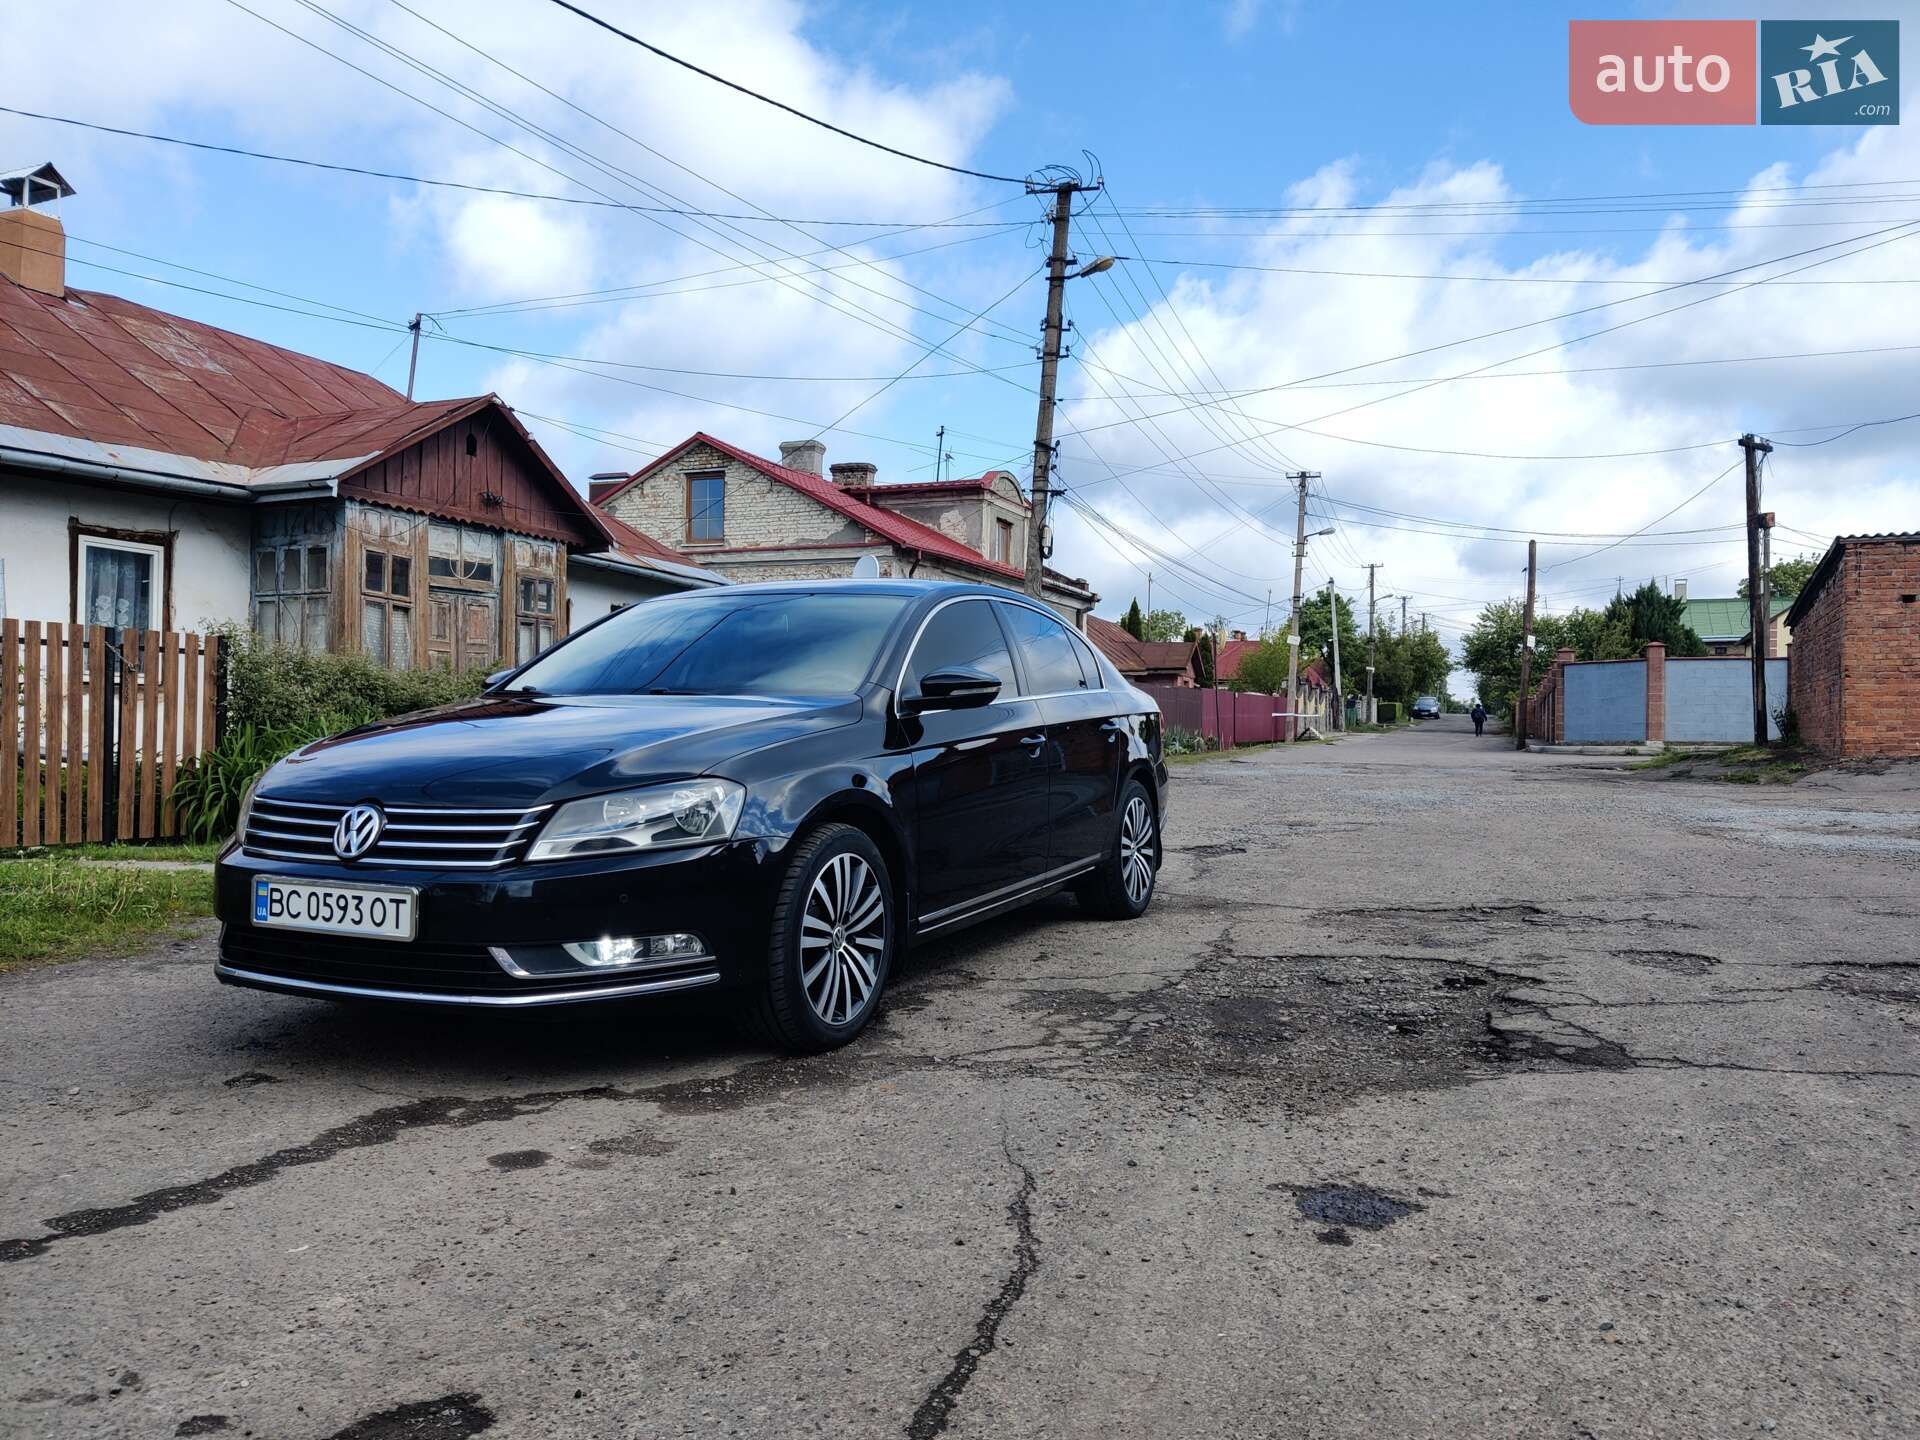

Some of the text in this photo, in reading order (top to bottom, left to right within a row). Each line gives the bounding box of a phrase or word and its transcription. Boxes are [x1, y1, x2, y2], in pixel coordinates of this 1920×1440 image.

[257, 906, 267, 916] UA
[269, 887, 407, 930] BC 0593 OT
